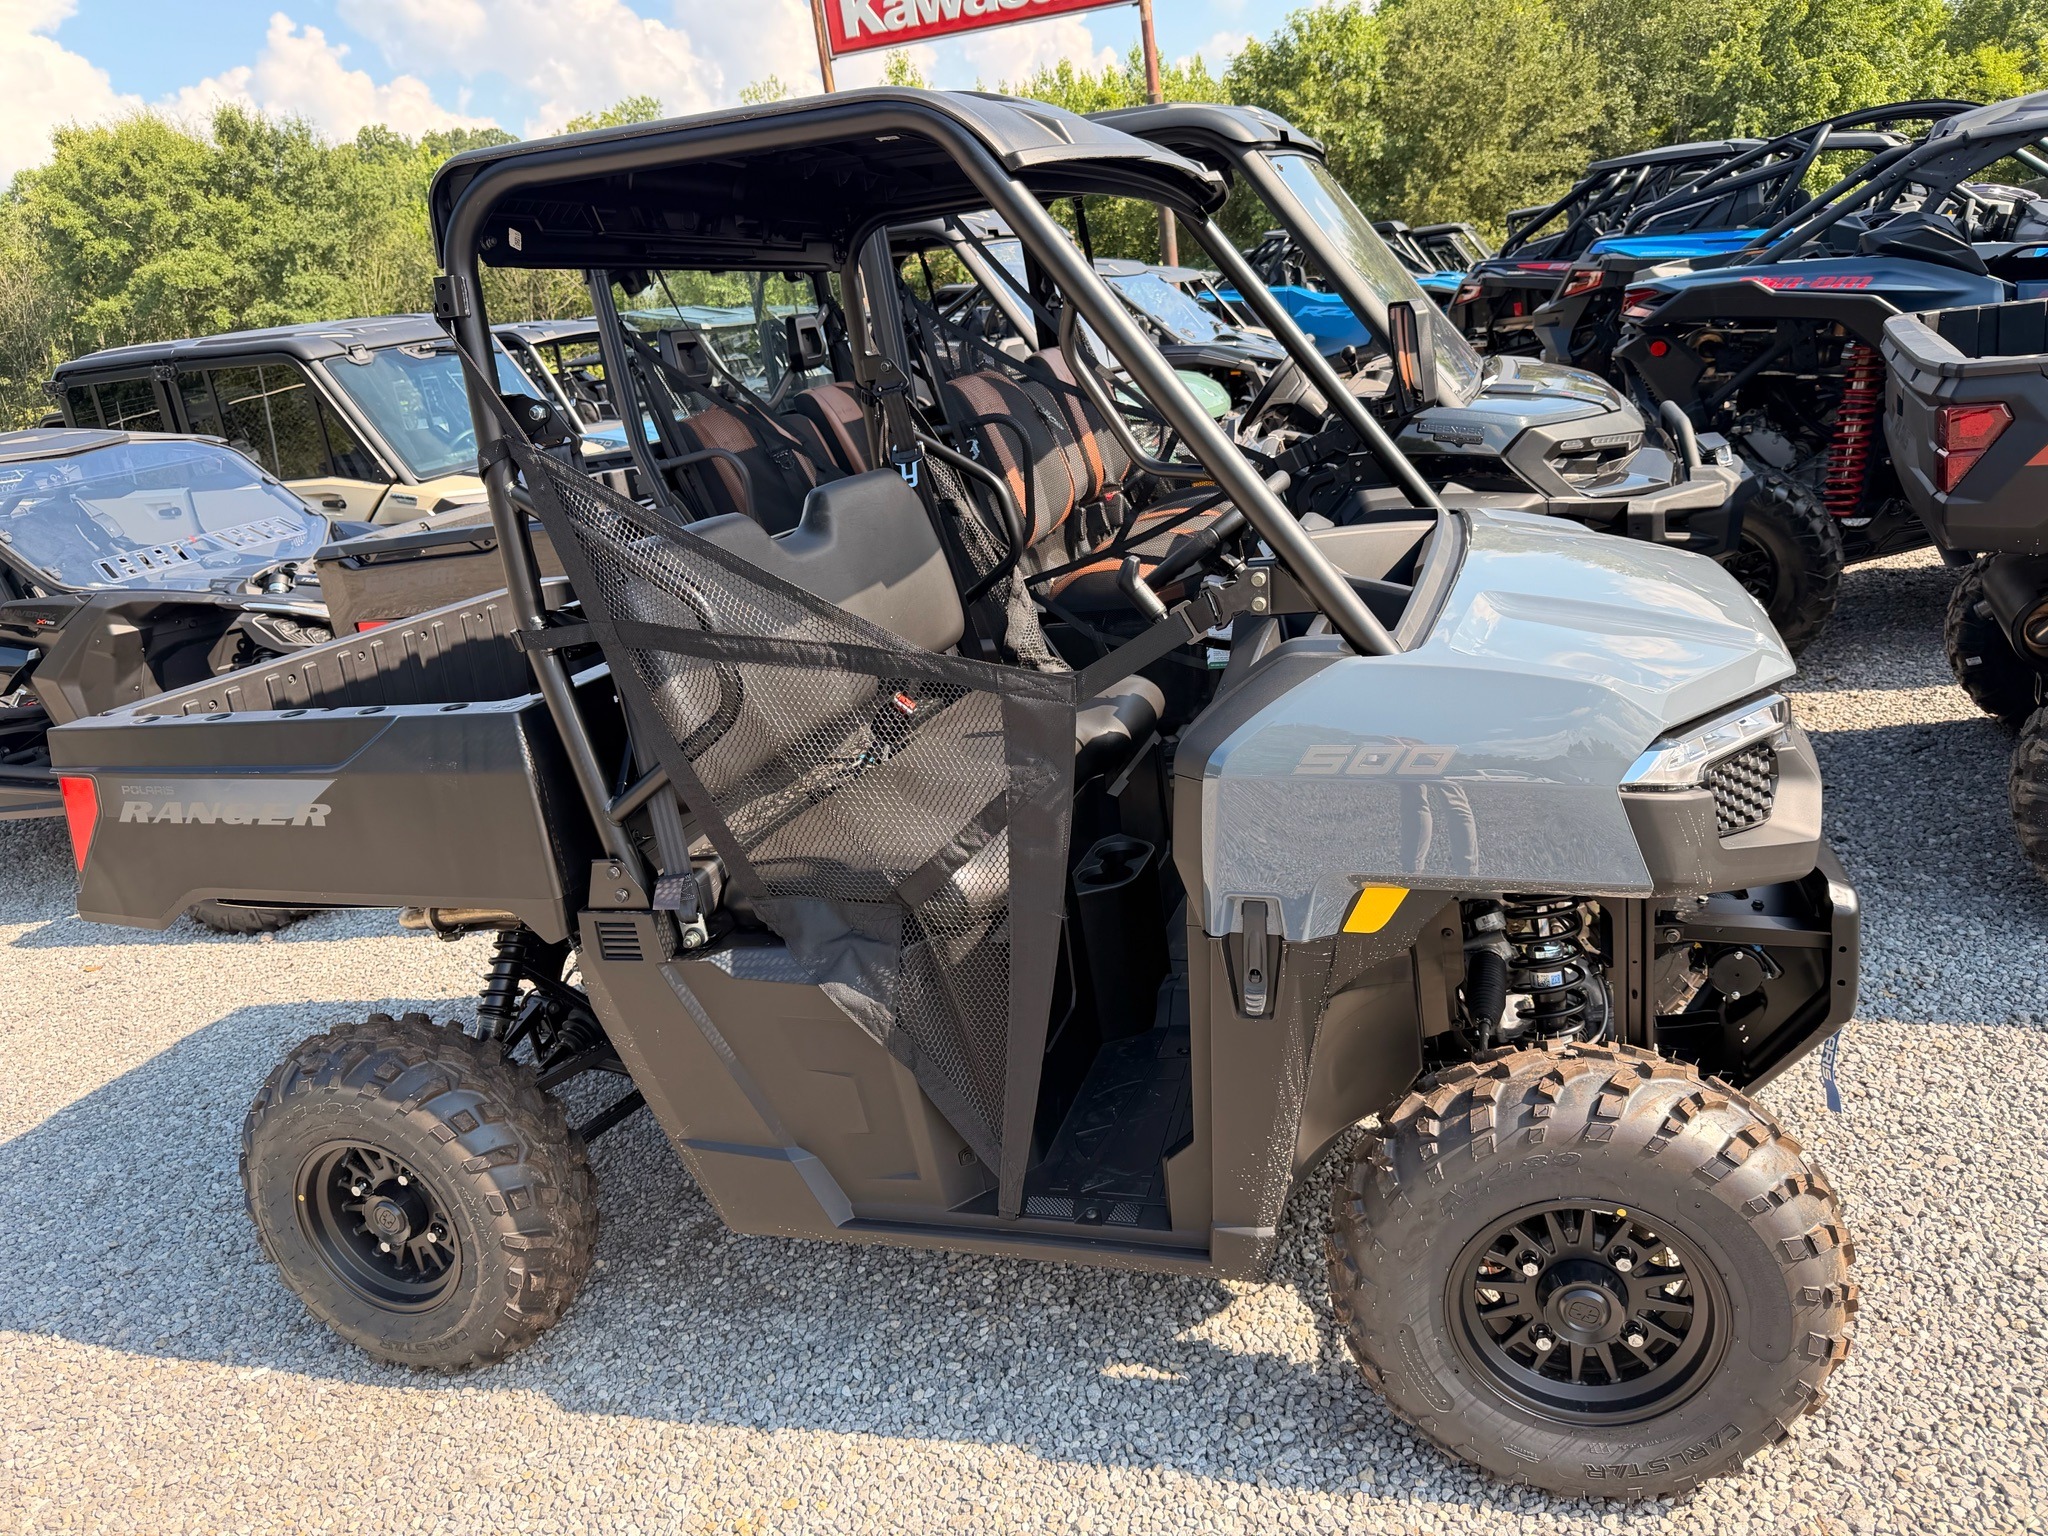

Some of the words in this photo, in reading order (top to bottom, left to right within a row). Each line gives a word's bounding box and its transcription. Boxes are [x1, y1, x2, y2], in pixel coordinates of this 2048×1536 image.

[1291, 745, 1458, 775] 500
[121, 785, 175, 795] POLARIS
[119, 801, 332, 827] RANGER
[1582, 1422, 1743, 1480] CARLSTAR
